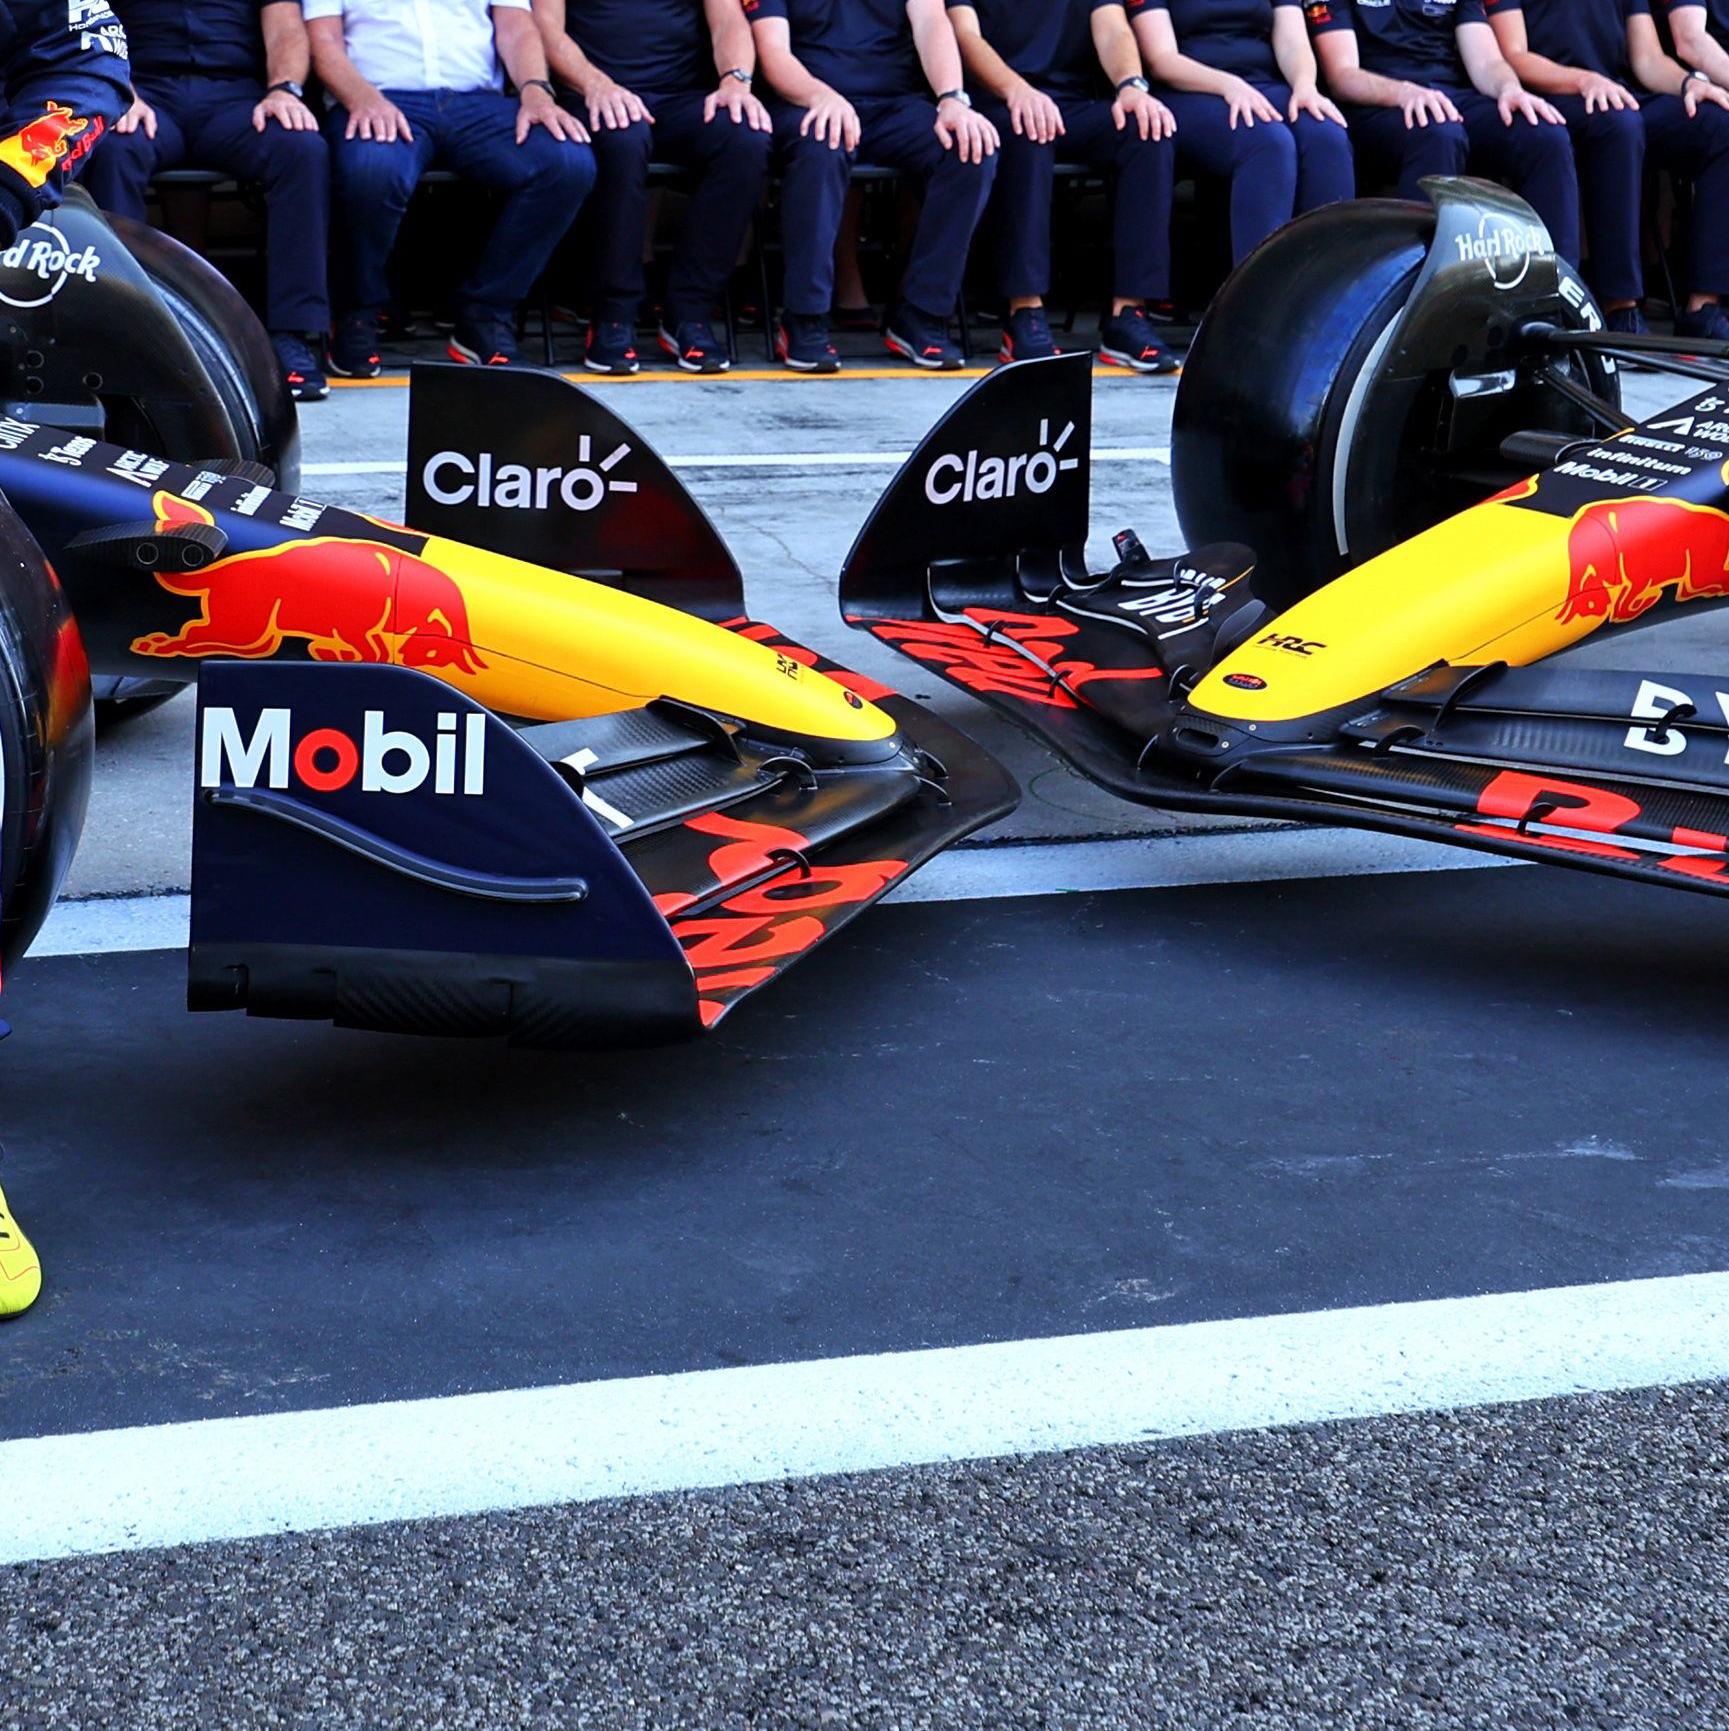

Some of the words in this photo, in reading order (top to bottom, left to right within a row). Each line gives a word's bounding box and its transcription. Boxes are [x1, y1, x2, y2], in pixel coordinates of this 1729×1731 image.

[27, 241, 101, 282] Rock
[1455, 229, 1501, 261] Hard
[1501, 225, 1544, 259] Rock
[423, 451, 605, 511] Claro
[925, 450, 1056, 505] Claro
[1554, 460, 1635, 488] Mobil
[1587, 447, 1692, 476] infinitum
[201, 707, 486, 796] Mobil
